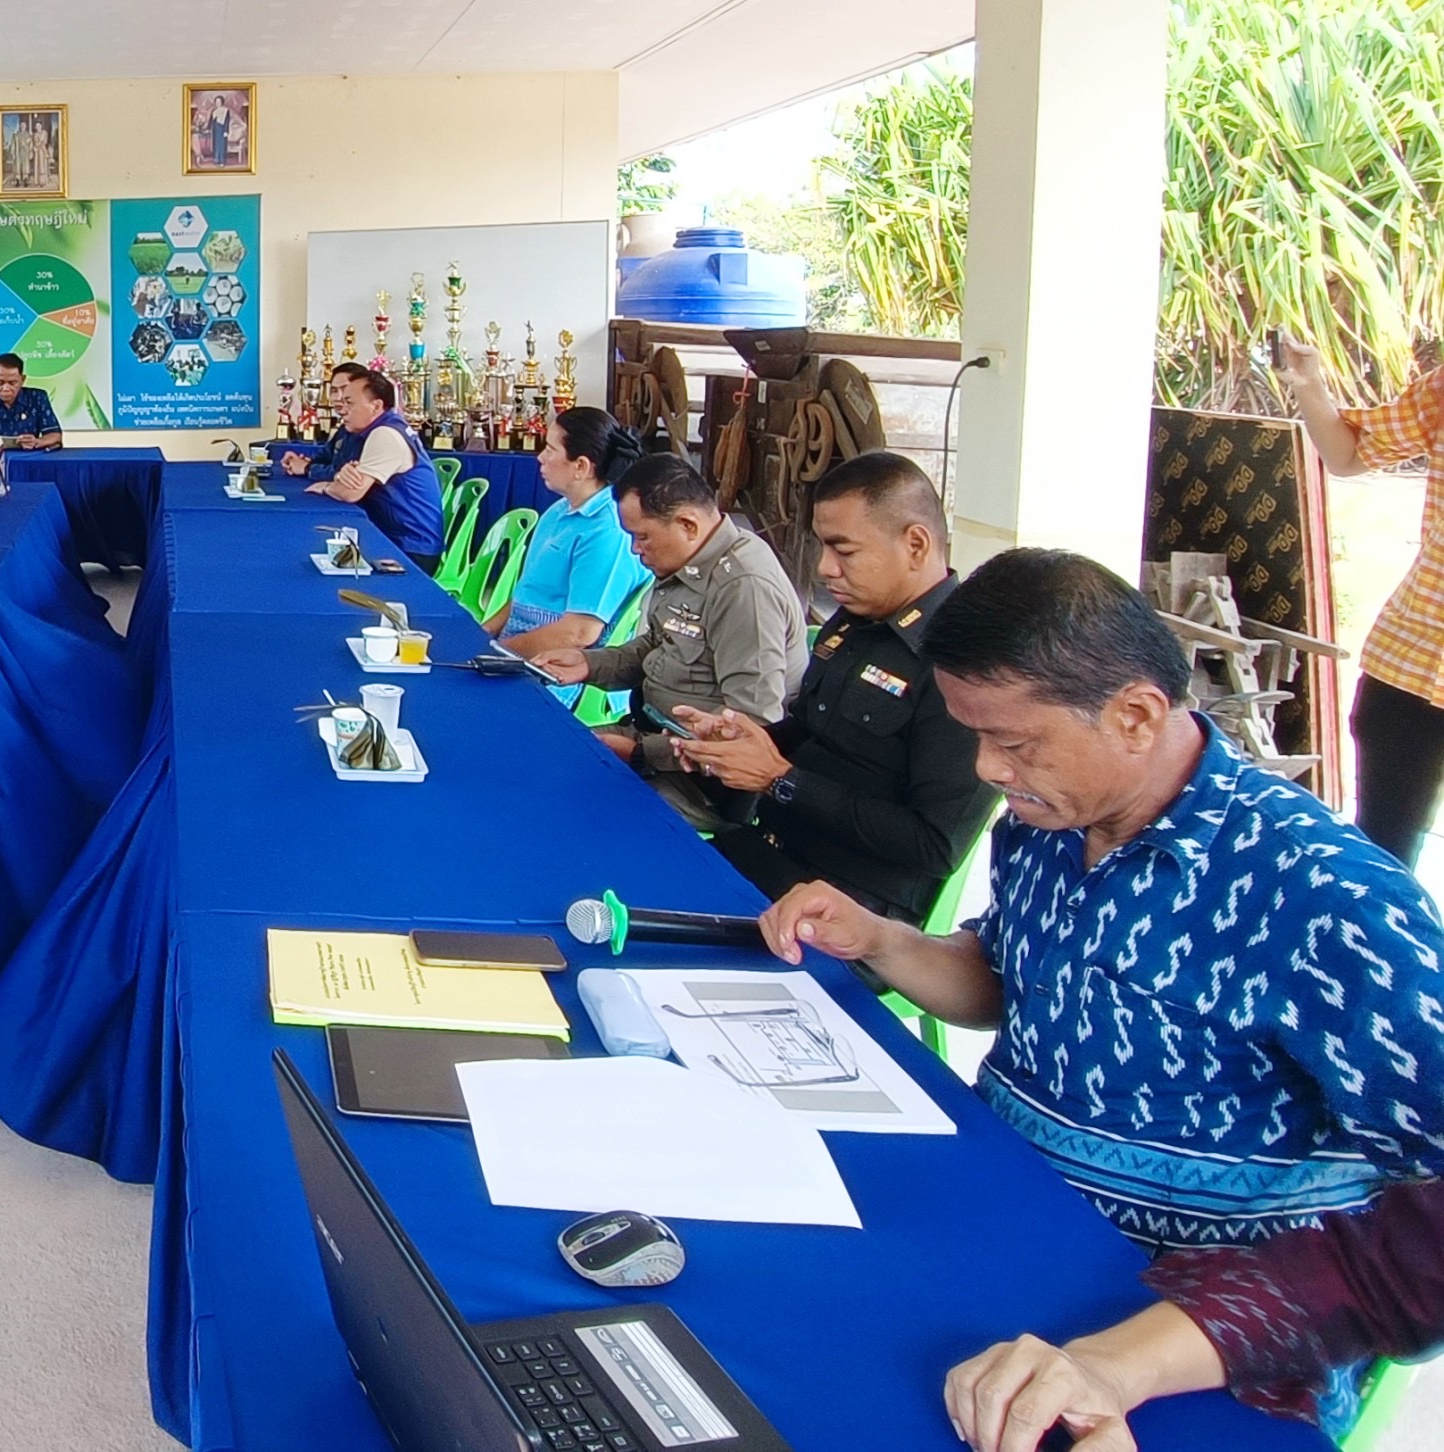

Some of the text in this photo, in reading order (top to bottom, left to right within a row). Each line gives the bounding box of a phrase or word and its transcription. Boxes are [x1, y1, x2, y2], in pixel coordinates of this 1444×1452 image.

[36, 271, 53, 279] 30%
[28, 283, 60, 291] ทำนาข้าว
[75, 308, 91, 316] 10%
[36, 340, 53, 348] 30%
